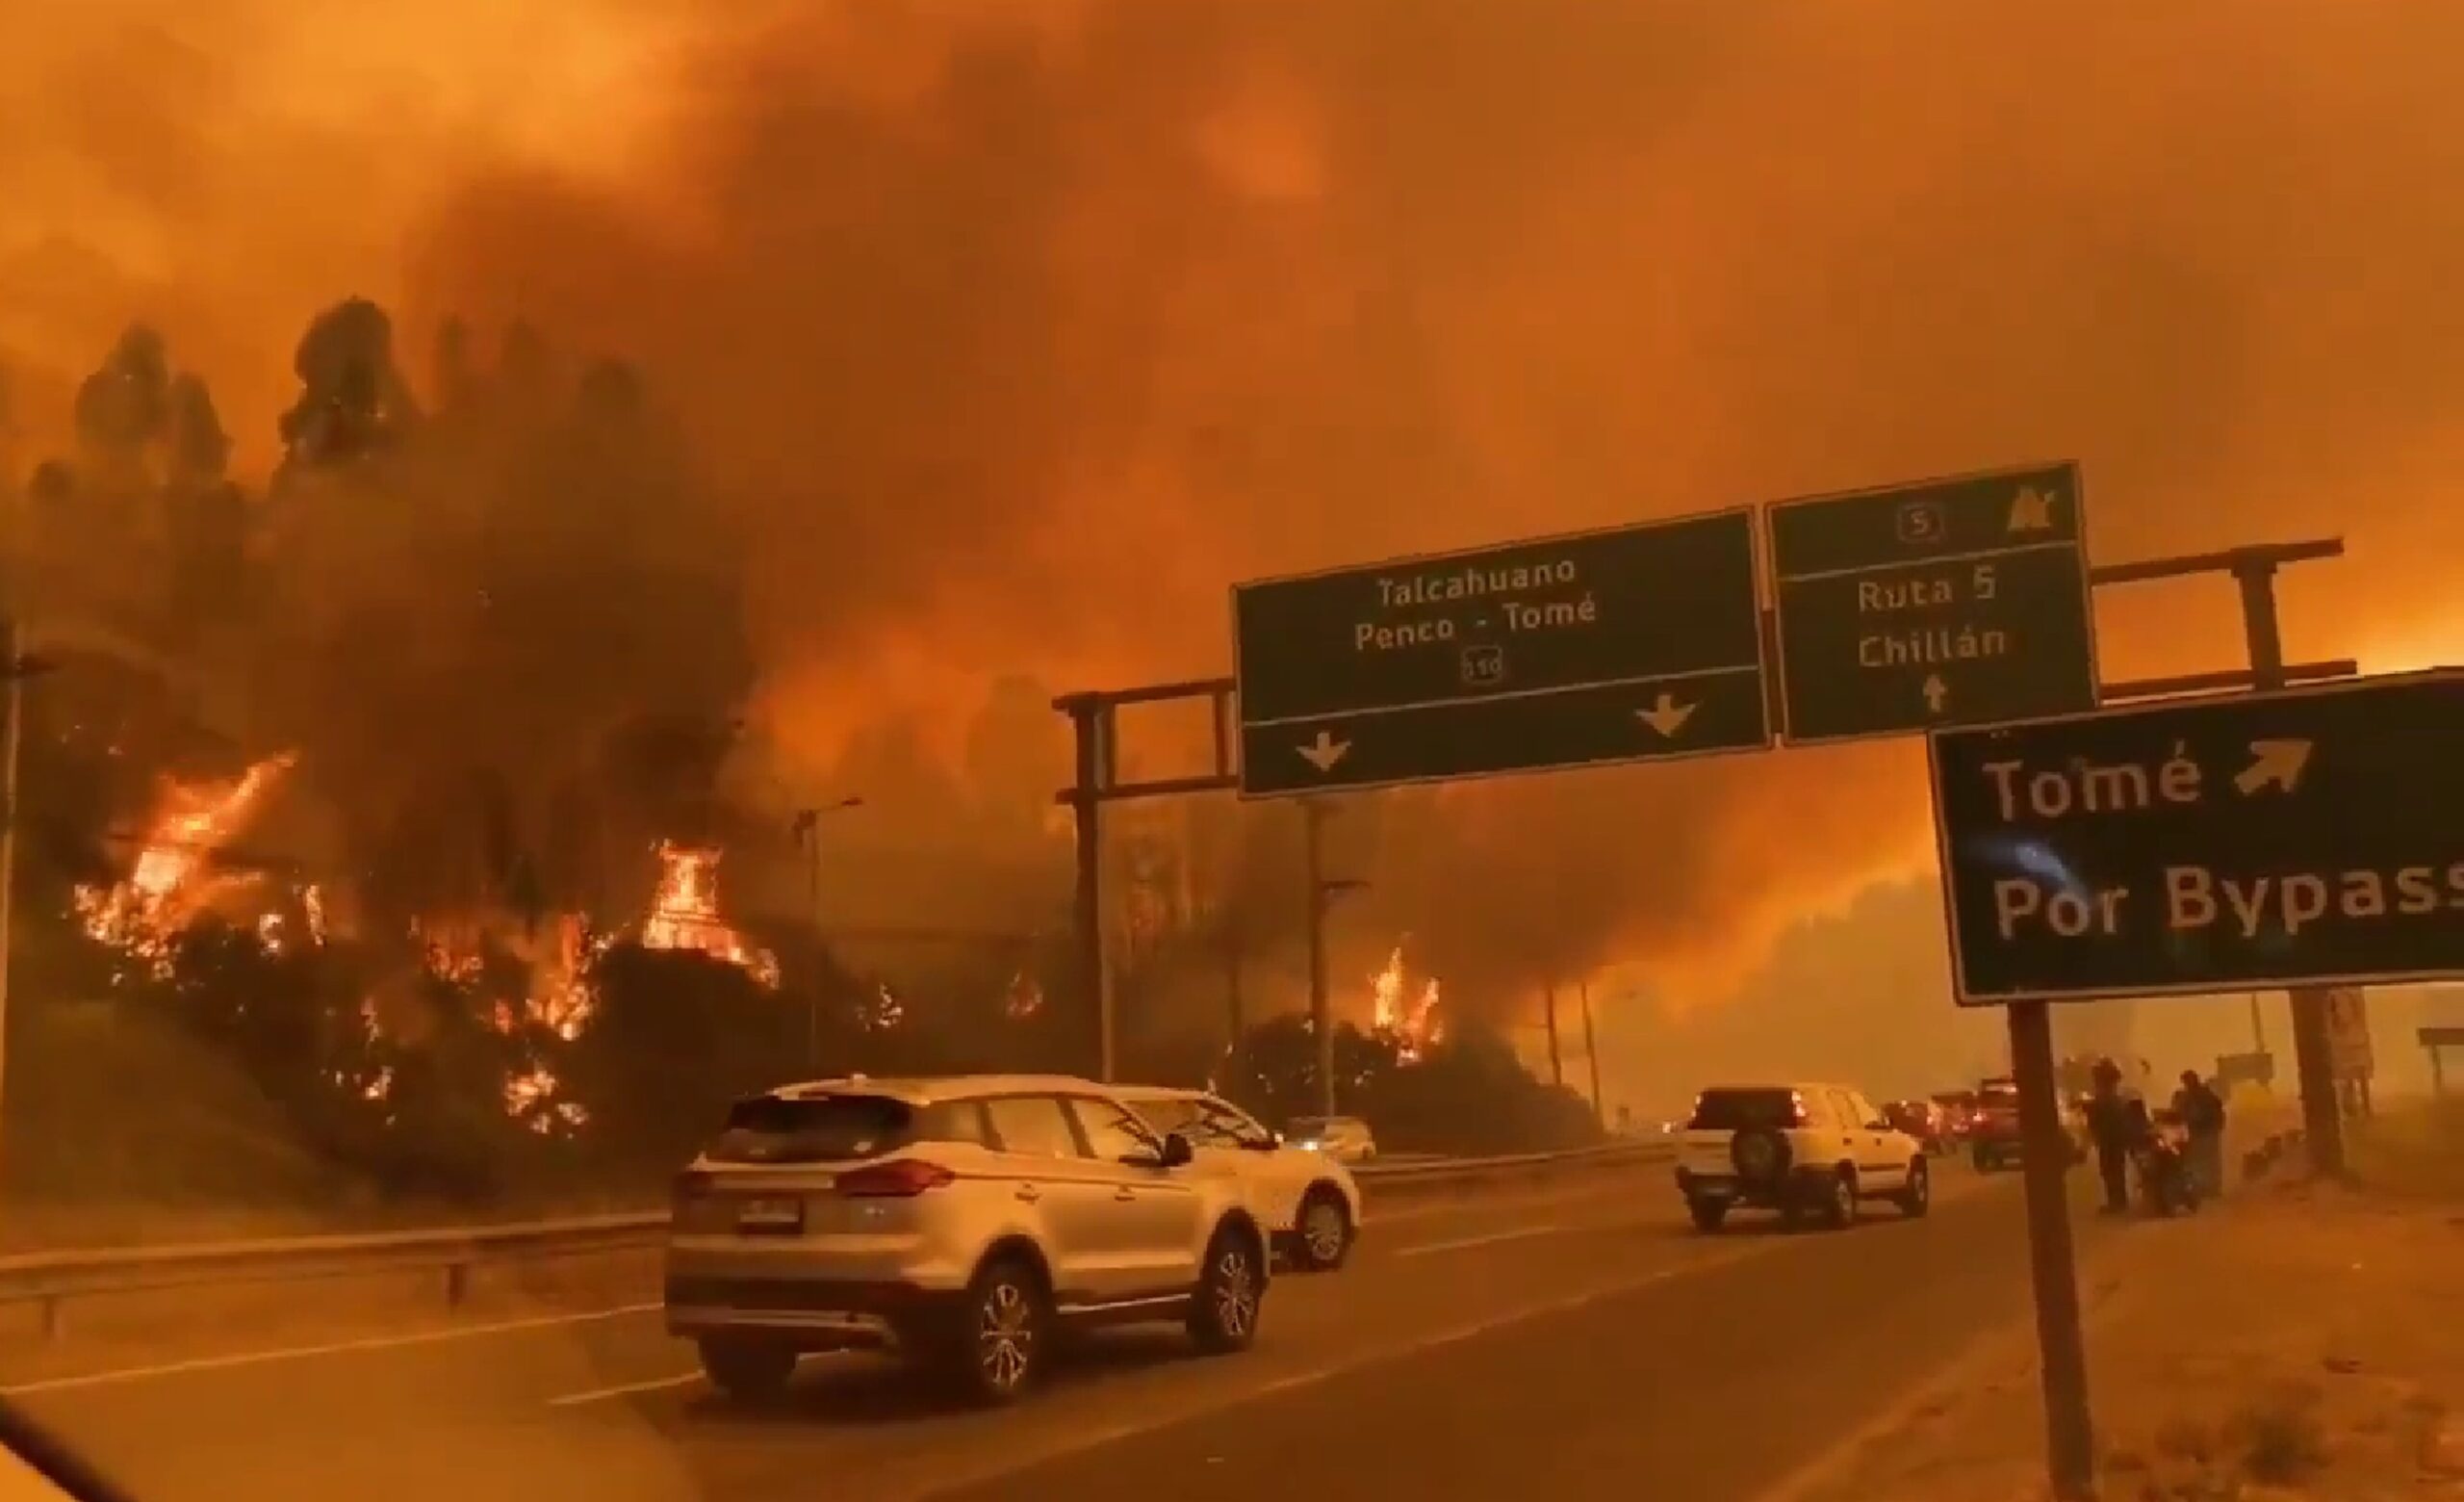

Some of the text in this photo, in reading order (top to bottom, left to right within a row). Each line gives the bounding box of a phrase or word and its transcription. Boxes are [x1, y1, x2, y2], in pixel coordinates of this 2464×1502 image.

[1377, 558, 1576, 608] Talcahuano
[1859, 566, 1996, 612] Ruta 5
[1355, 618, 1454, 650] Penco
[1502, 594, 1596, 632] Tomé
[1859, 626, 2005, 666] Chillán
[1983, 739, 2201, 820] Tomé
[1994, 880, 2128, 940] Por
